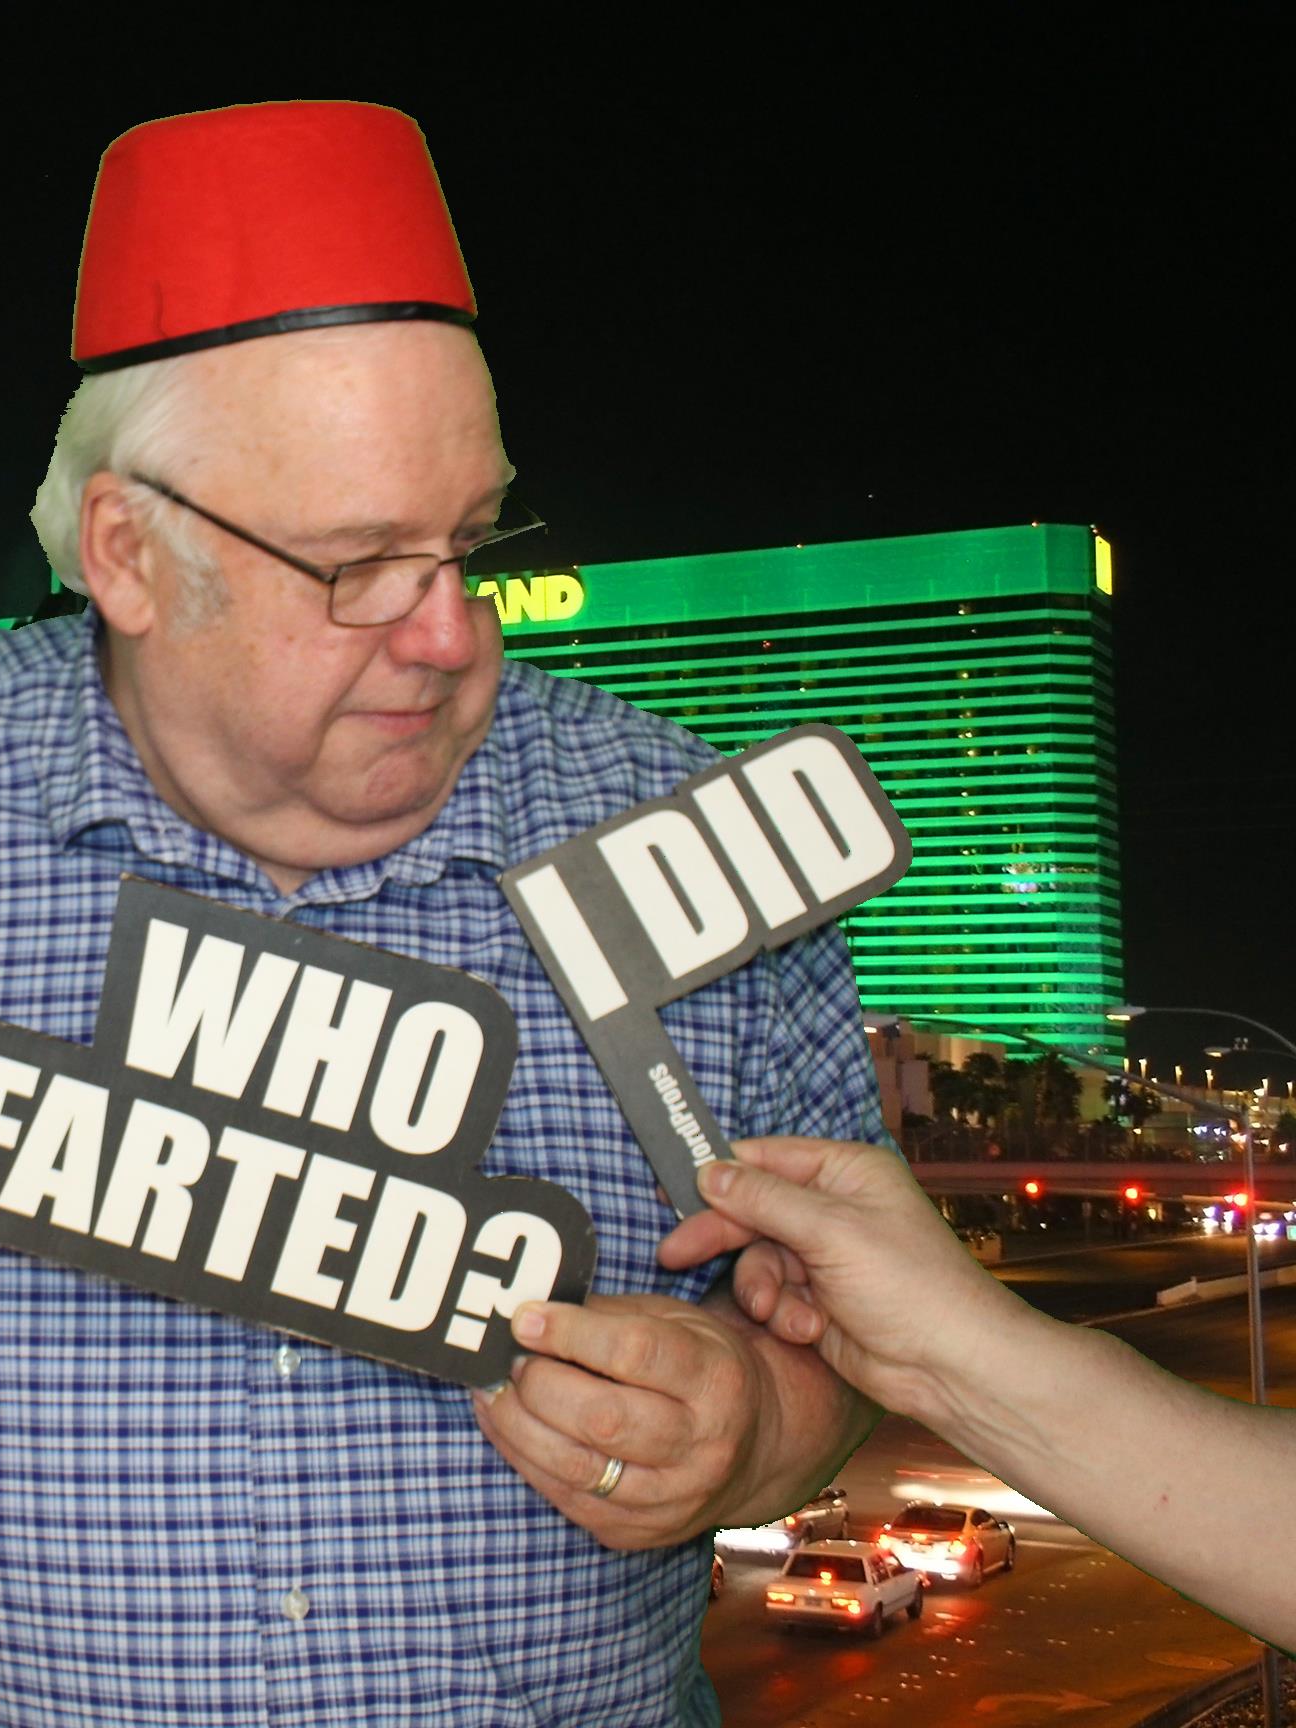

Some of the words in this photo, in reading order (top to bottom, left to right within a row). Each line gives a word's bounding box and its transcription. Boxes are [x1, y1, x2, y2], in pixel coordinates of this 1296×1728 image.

[515, 863, 629, 1022] I
[596, 735, 896, 980] DID
[125, 917, 484, 1155] WHO
